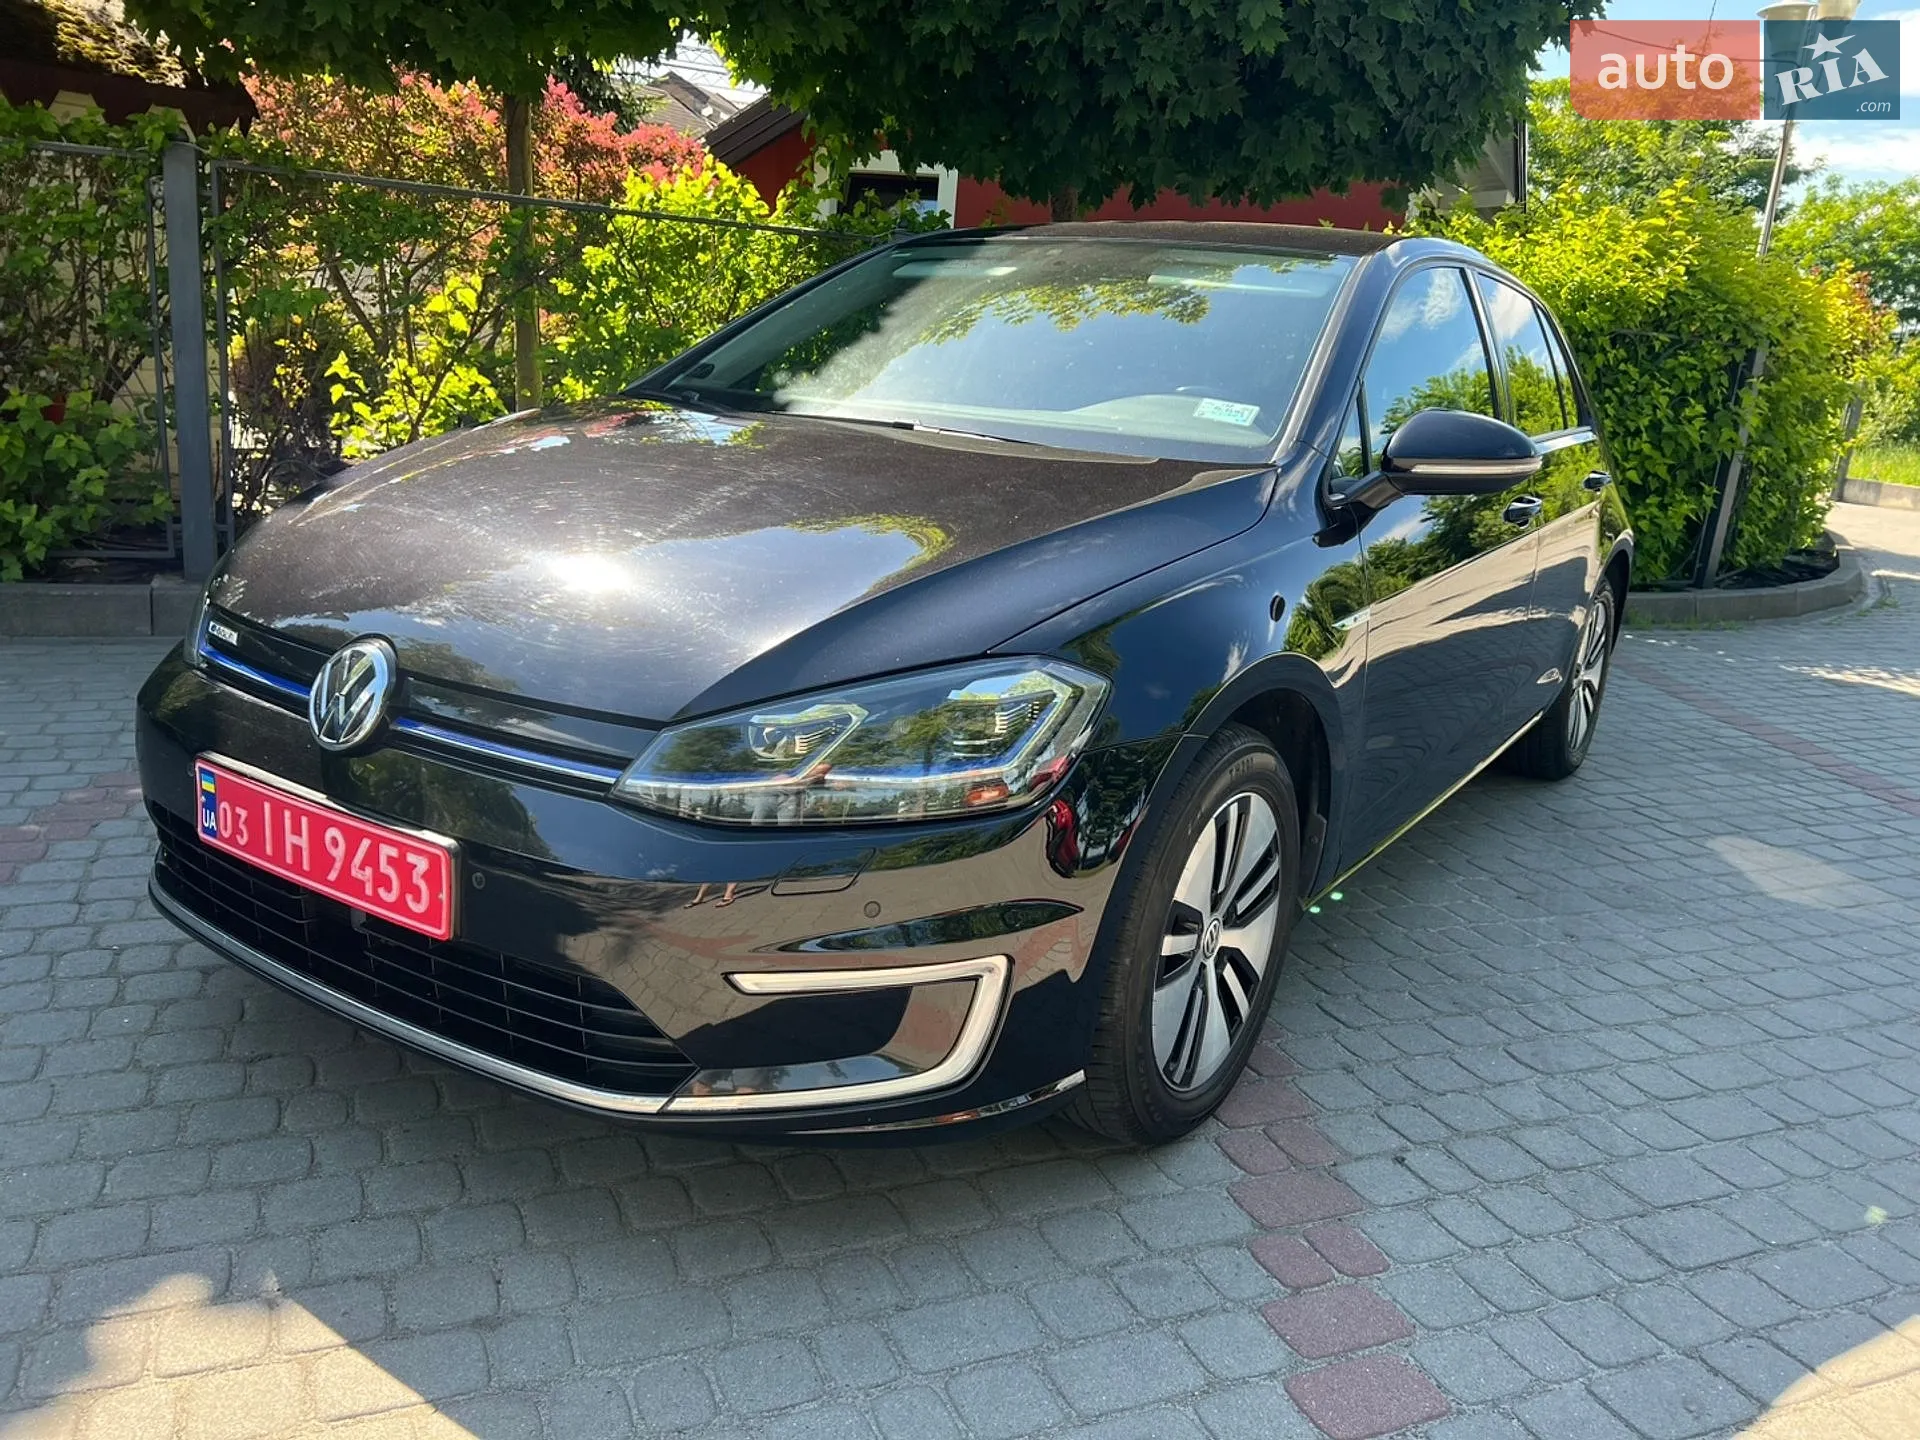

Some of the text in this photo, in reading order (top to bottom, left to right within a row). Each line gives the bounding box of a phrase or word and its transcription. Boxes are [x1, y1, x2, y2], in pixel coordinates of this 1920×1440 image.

[311, 645, 388, 745] VW
[202, 807, 217, 831] UA
[219, 800, 430, 914] 03 IH 9453
